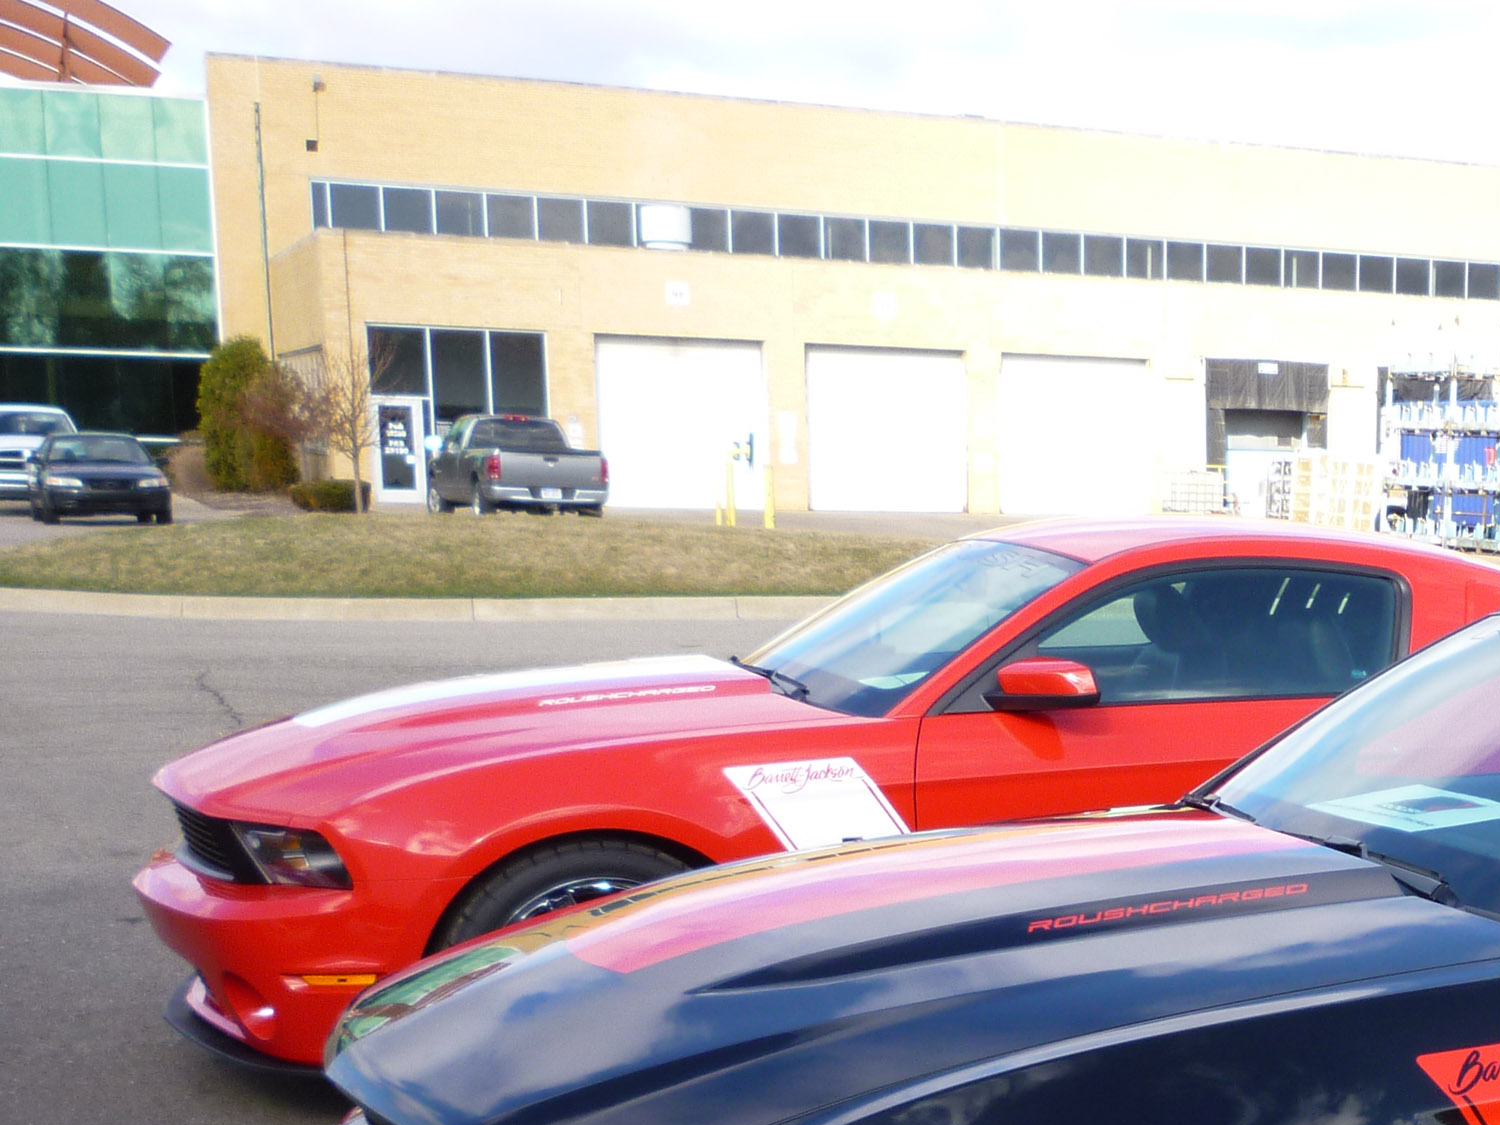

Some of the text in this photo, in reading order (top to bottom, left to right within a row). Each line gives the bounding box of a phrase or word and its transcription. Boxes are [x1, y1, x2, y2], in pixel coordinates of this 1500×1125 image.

[538, 684, 717, 707] ROUSHCHARGED
[743, 763, 865, 795] Barrett-Jackson
[1027, 882, 1309, 934] ROUSHCHARGED
